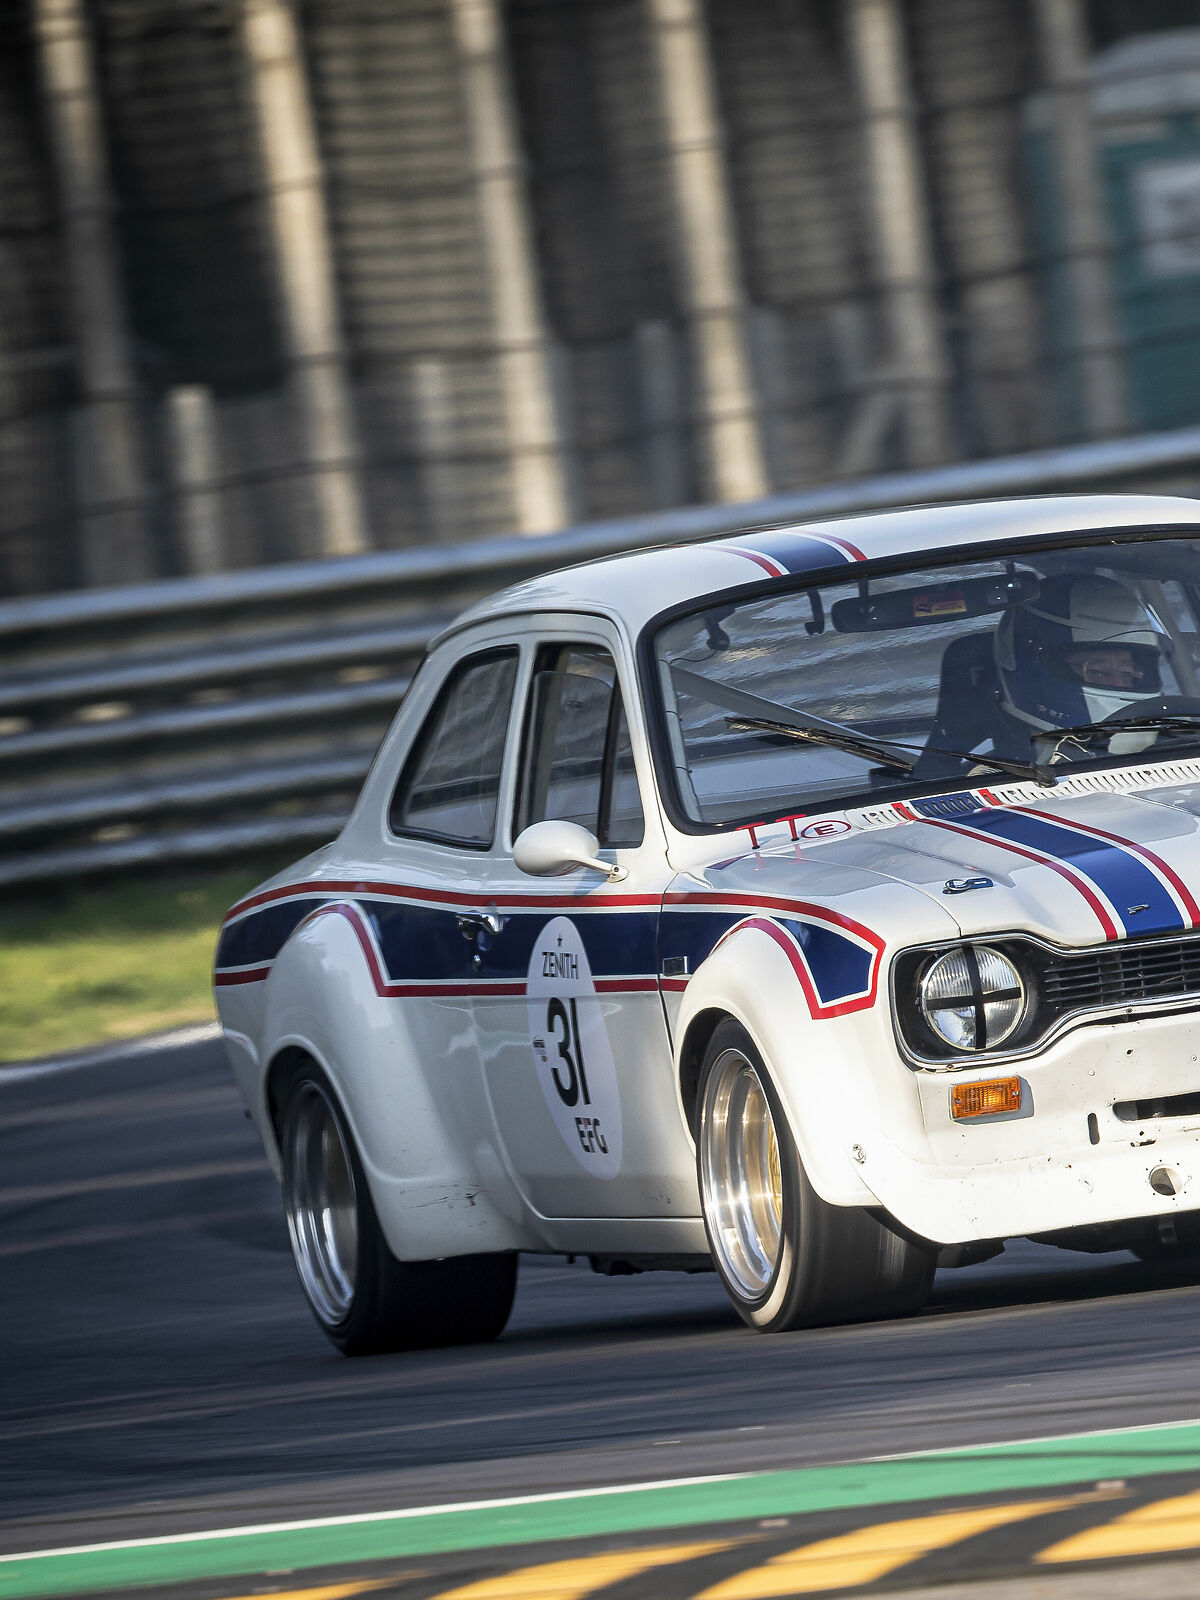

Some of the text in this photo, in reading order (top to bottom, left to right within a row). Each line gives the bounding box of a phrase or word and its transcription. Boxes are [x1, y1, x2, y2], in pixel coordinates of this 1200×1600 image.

[813, 823, 838, 837] E
[541, 951, 579, 980] ZENITH
[547, 996, 591, 1108] 31
[574, 1116, 609, 1155] EFG
